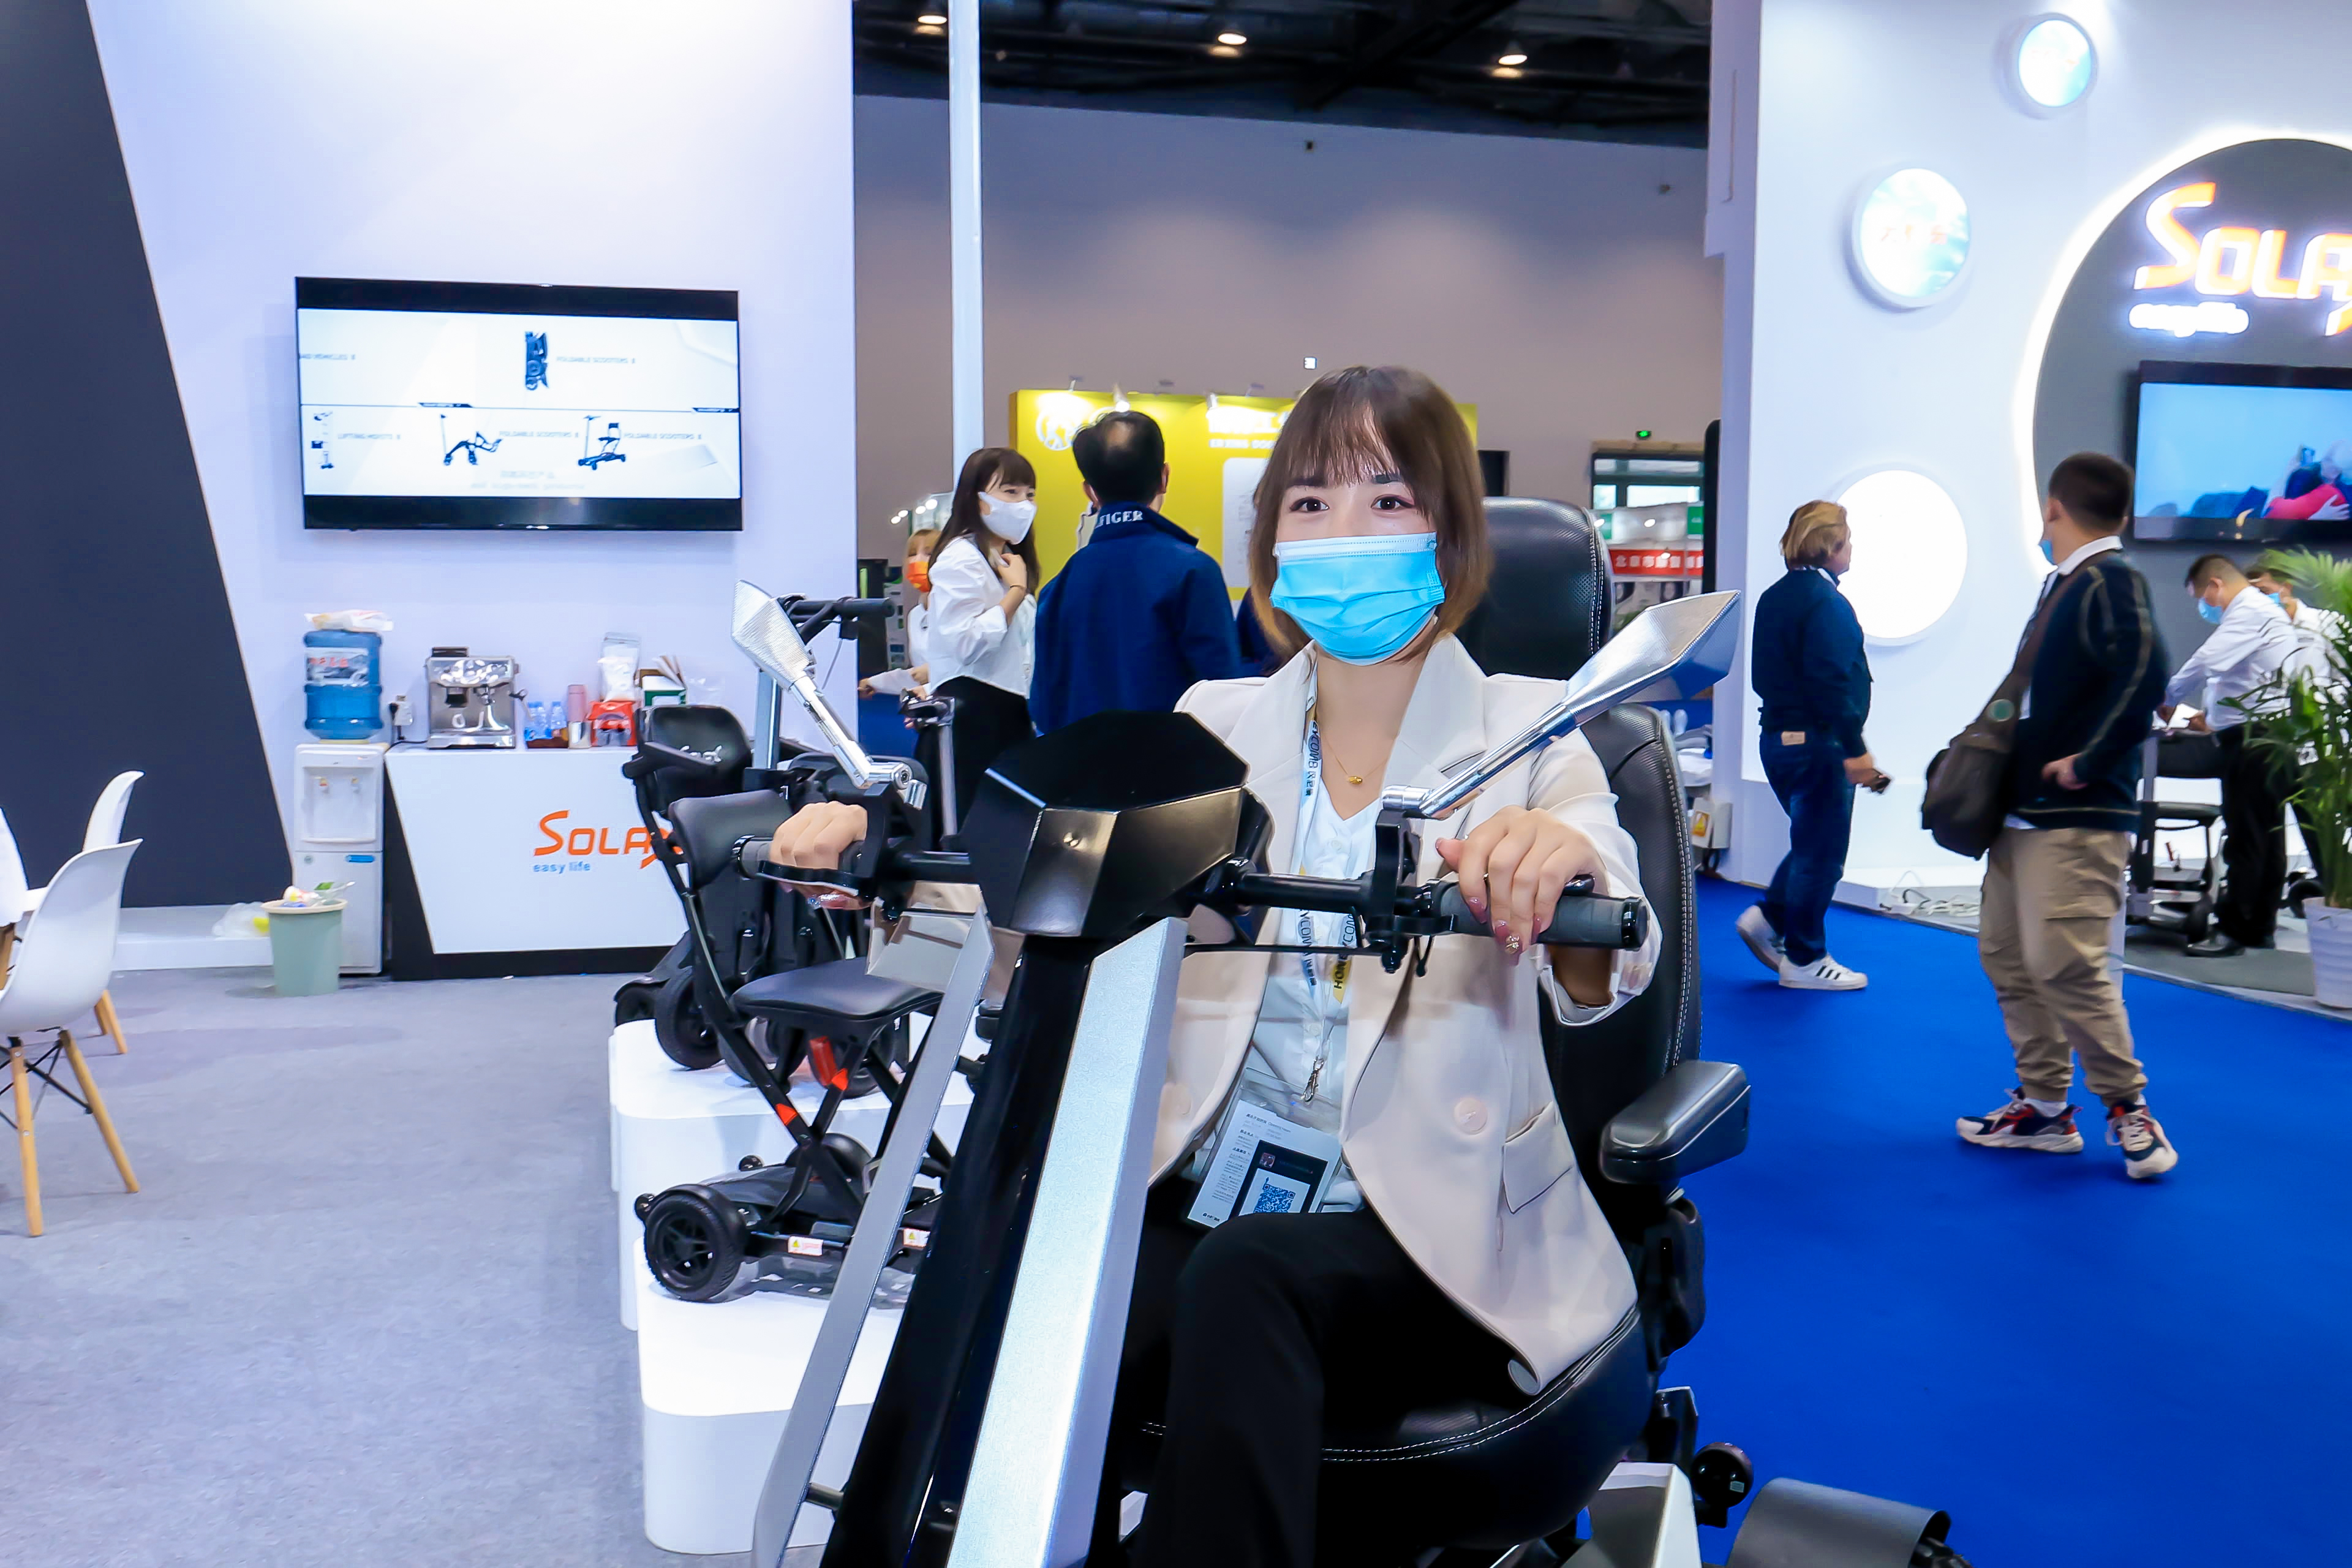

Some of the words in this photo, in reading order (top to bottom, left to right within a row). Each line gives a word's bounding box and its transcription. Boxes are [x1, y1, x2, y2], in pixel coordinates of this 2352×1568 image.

[2134, 181, 2352, 336] SOLA
[533, 862, 565, 874] easy
[569, 861, 591, 872] life
